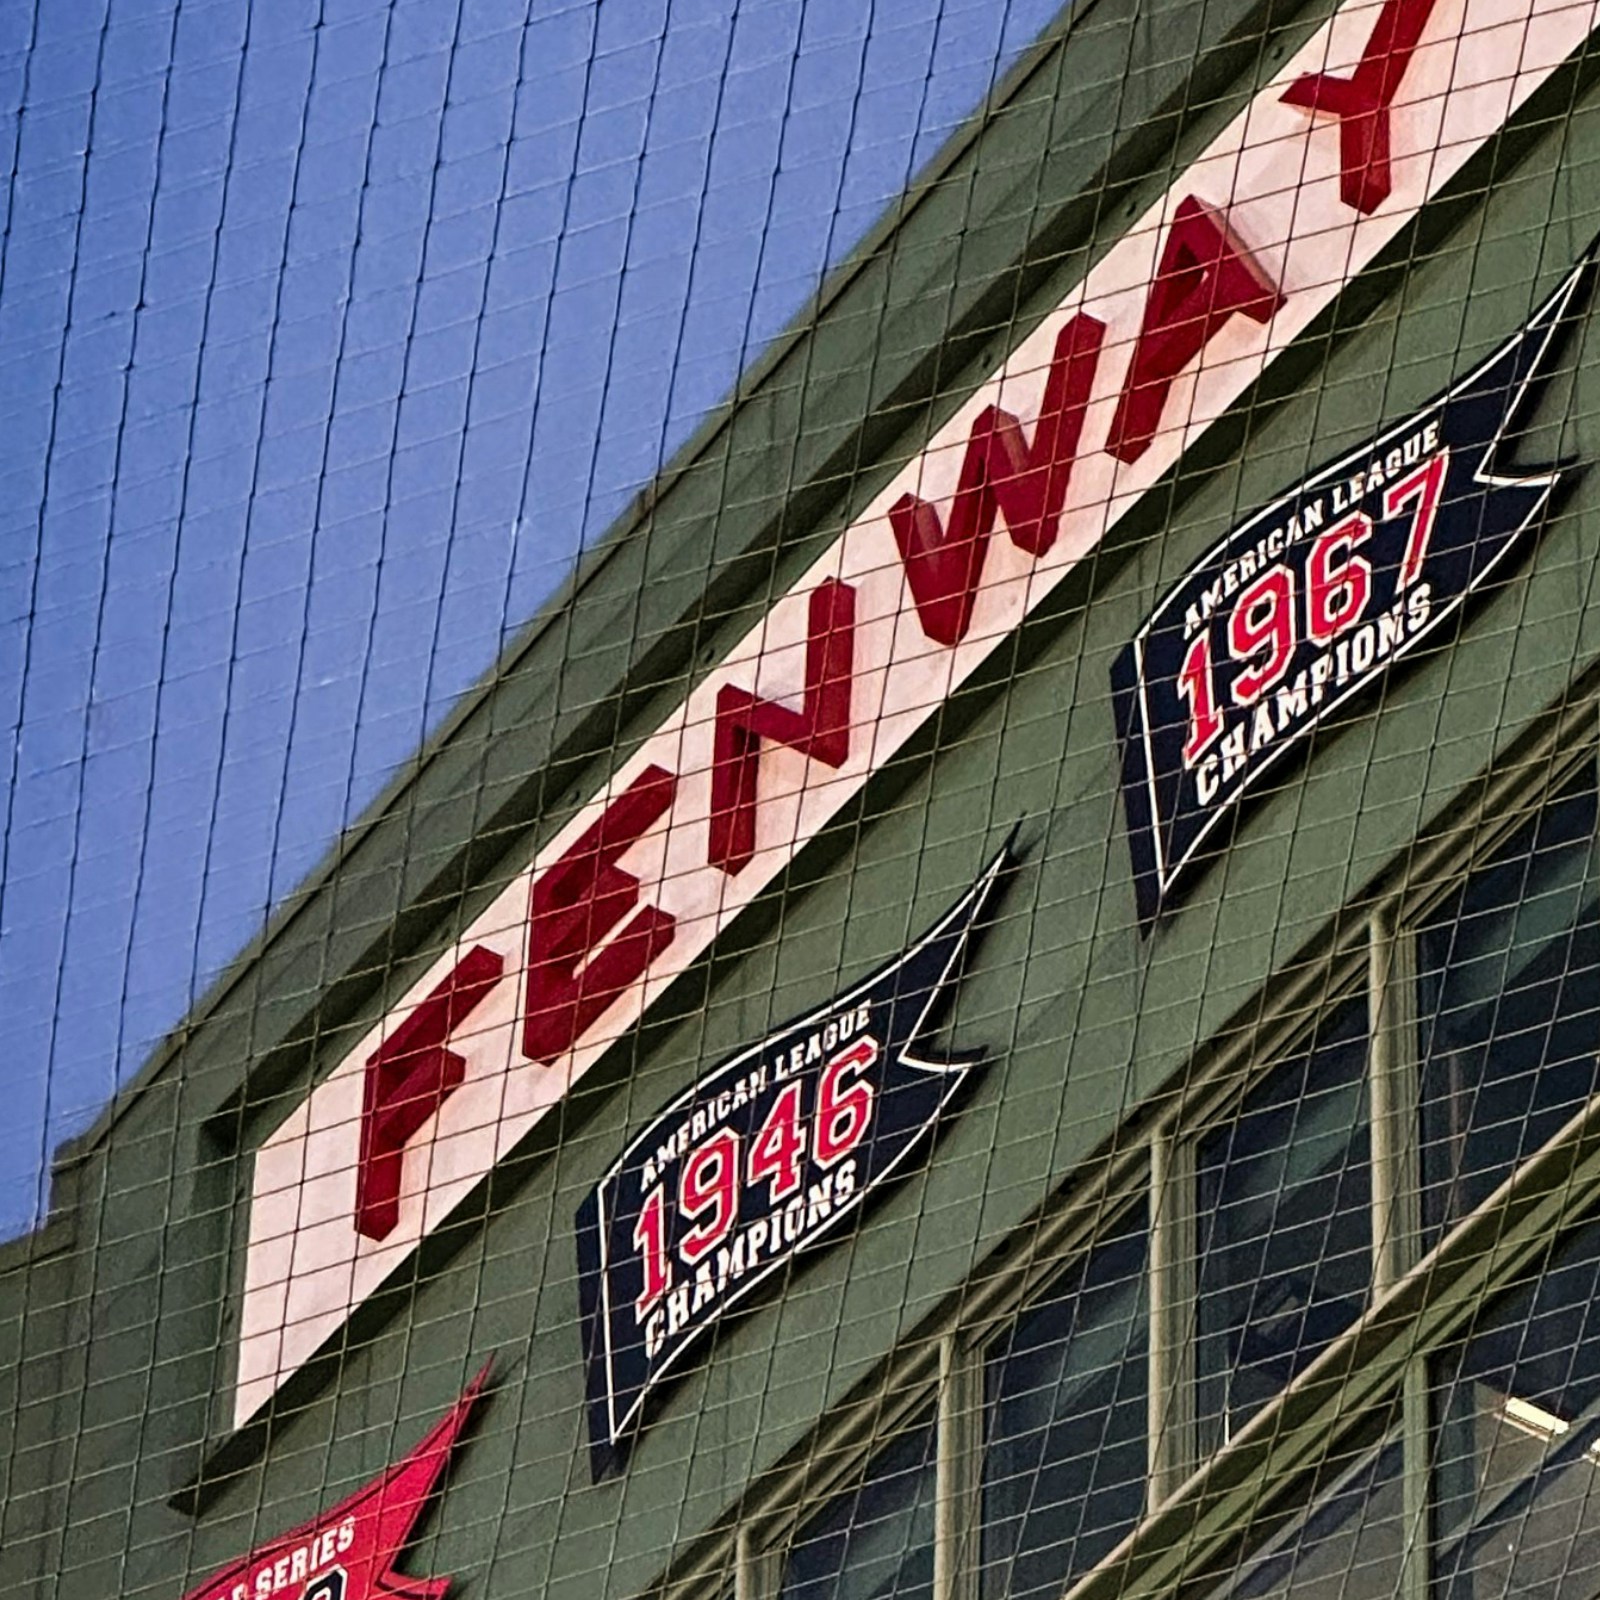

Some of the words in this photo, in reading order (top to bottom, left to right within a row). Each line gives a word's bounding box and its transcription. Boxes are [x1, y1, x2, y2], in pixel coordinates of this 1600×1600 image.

[1177, 446, 1449, 770] 1967
[1183, 497, 1322, 640] AMERICAN
[1331, 420, 1440, 521] LEAGUE
[1196, 582, 1431, 806] CHAMPIONS
[633, 1037, 878, 1322] 1946
[640, 1071, 766, 1191] AMERICAN
[774, 999, 872, 1092] LEAGUE
[644, 1158, 856, 1359] CHAMPIONS
